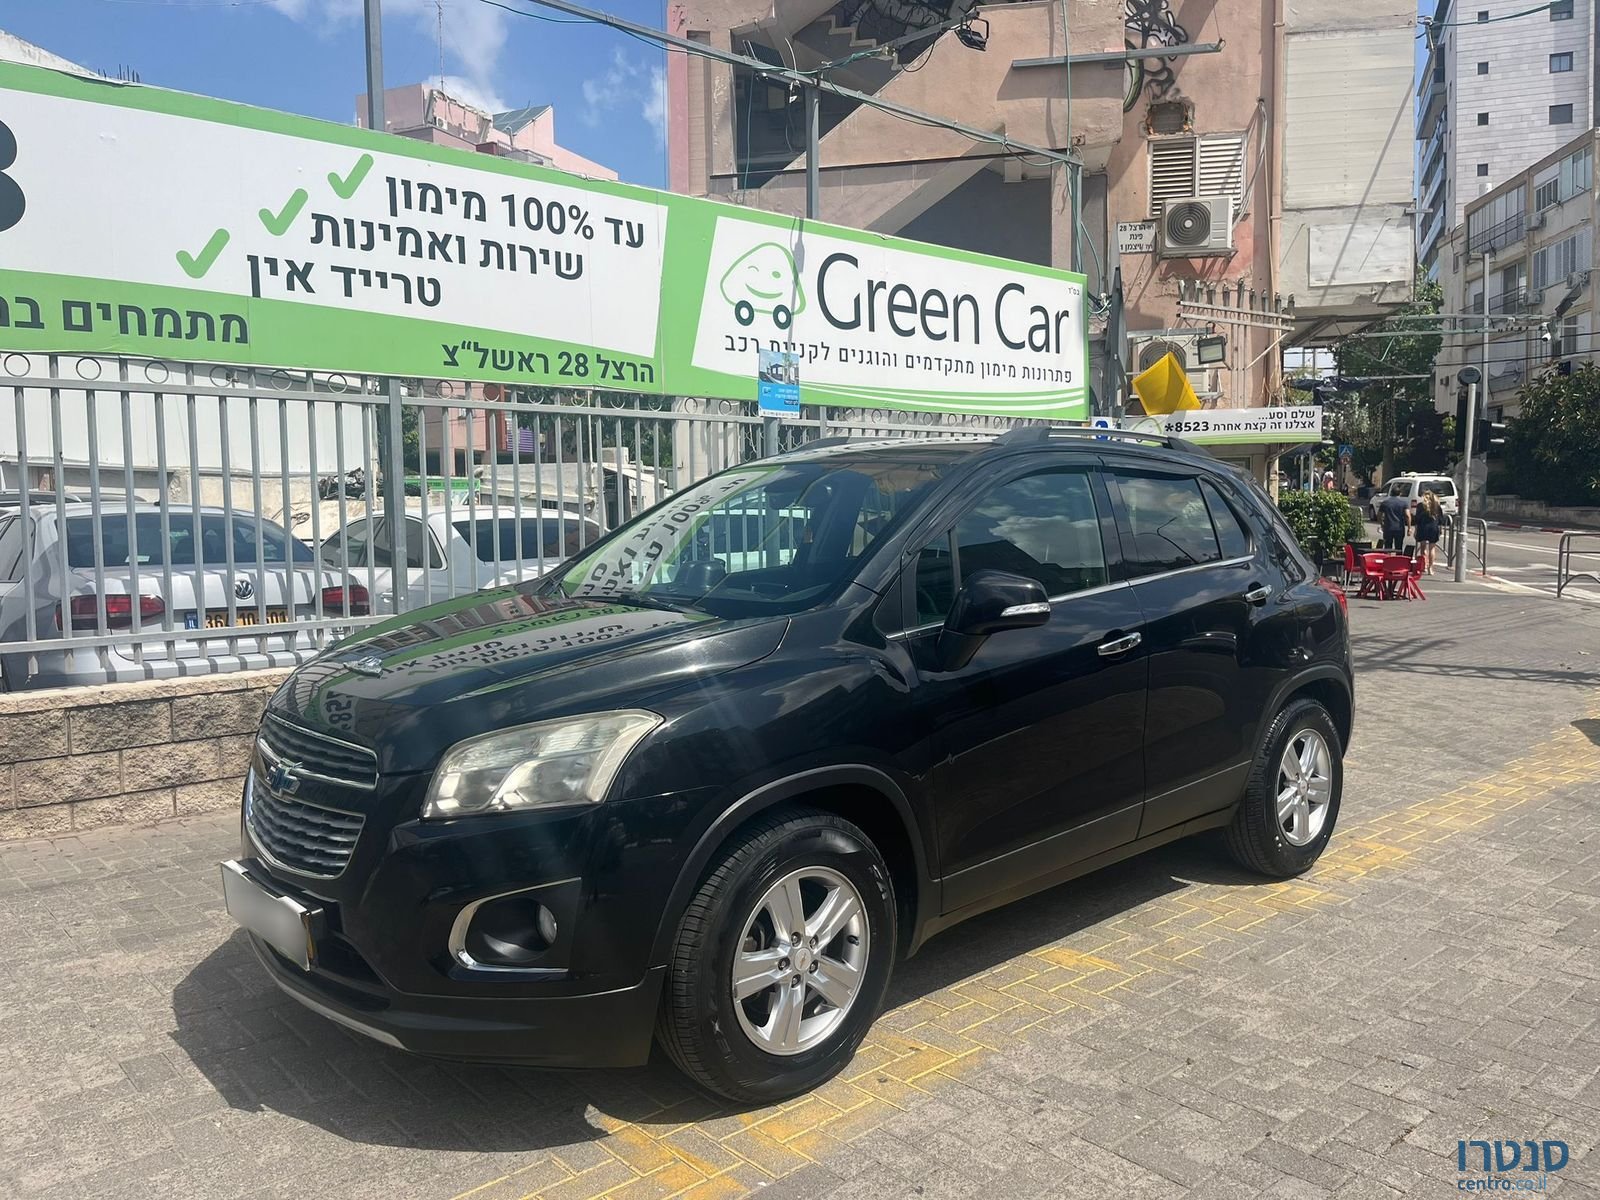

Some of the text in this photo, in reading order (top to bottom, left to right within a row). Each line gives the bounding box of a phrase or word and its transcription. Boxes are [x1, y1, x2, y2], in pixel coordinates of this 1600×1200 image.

[385, 176, 645, 249] עד 100% מימון
[310, 212, 583, 280] שירות ואמינות
[247, 254, 441, 307] טרייד אין
[817, 252, 1069, 354] Green Car
[62, 299, 249, 344] מתמחים
[725, 335, 760, 353] רכב
[558, 351, 589, 377] 28
[839, 348, 897, 367] והוגנים
[906, 354, 974, 376] מתקדמים
[596, 354, 654, 383] הרצל
[980, 361, 1017, 379] מימון
[1022, 366, 1072, 384] פתרונות
[1290, 409, 1315, 419] שלם
[1213, 423, 1241, 431] אחרת
[1244, 422, 1267, 432] קצת
[1270, 421, 1281, 430] זה
[1285, 420, 1315, 430] אצלנו
